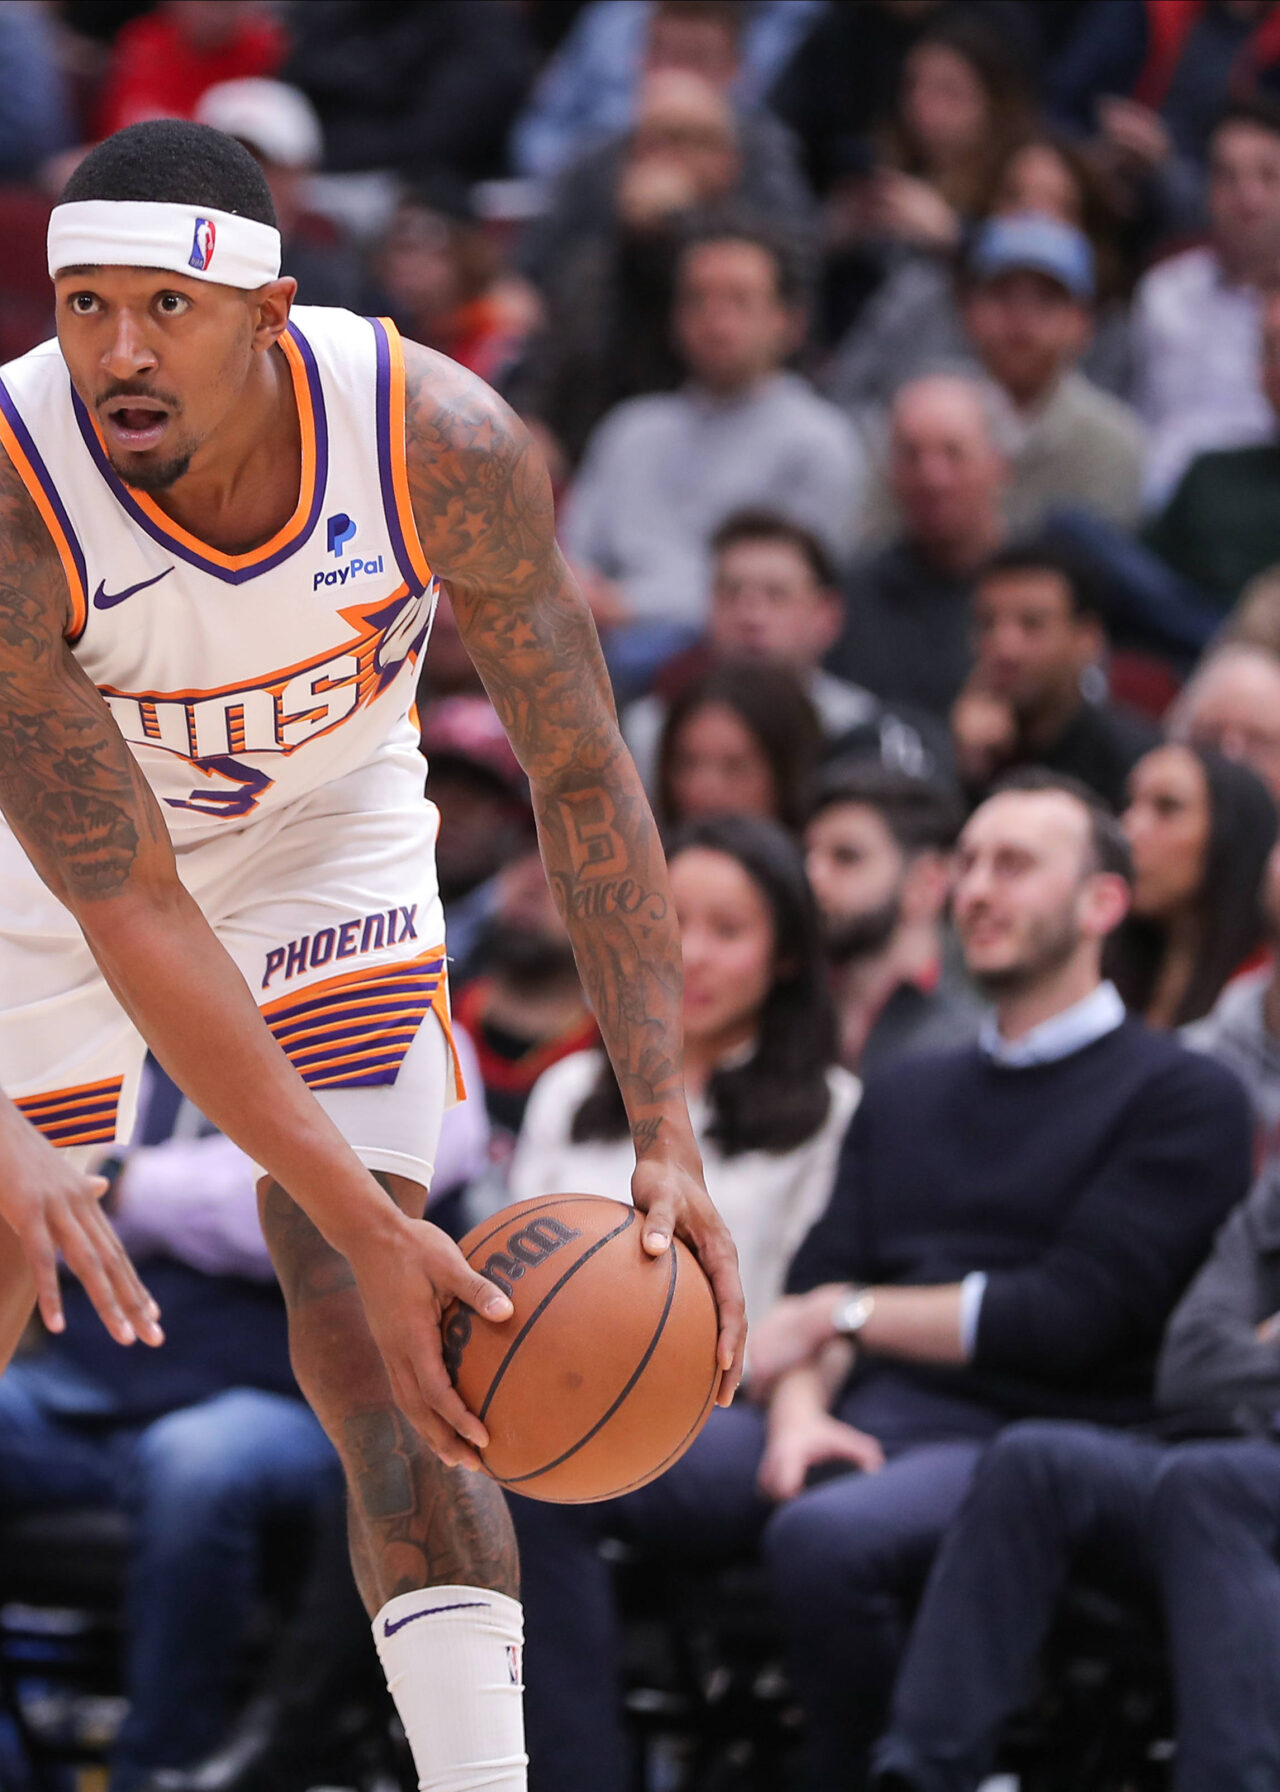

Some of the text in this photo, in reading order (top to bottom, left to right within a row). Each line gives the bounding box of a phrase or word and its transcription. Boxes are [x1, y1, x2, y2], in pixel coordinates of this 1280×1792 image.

[313, 554, 384, 591] PayPal
[102, 653, 361, 759] UNS
[262, 903, 418, 990] PHOENIX
